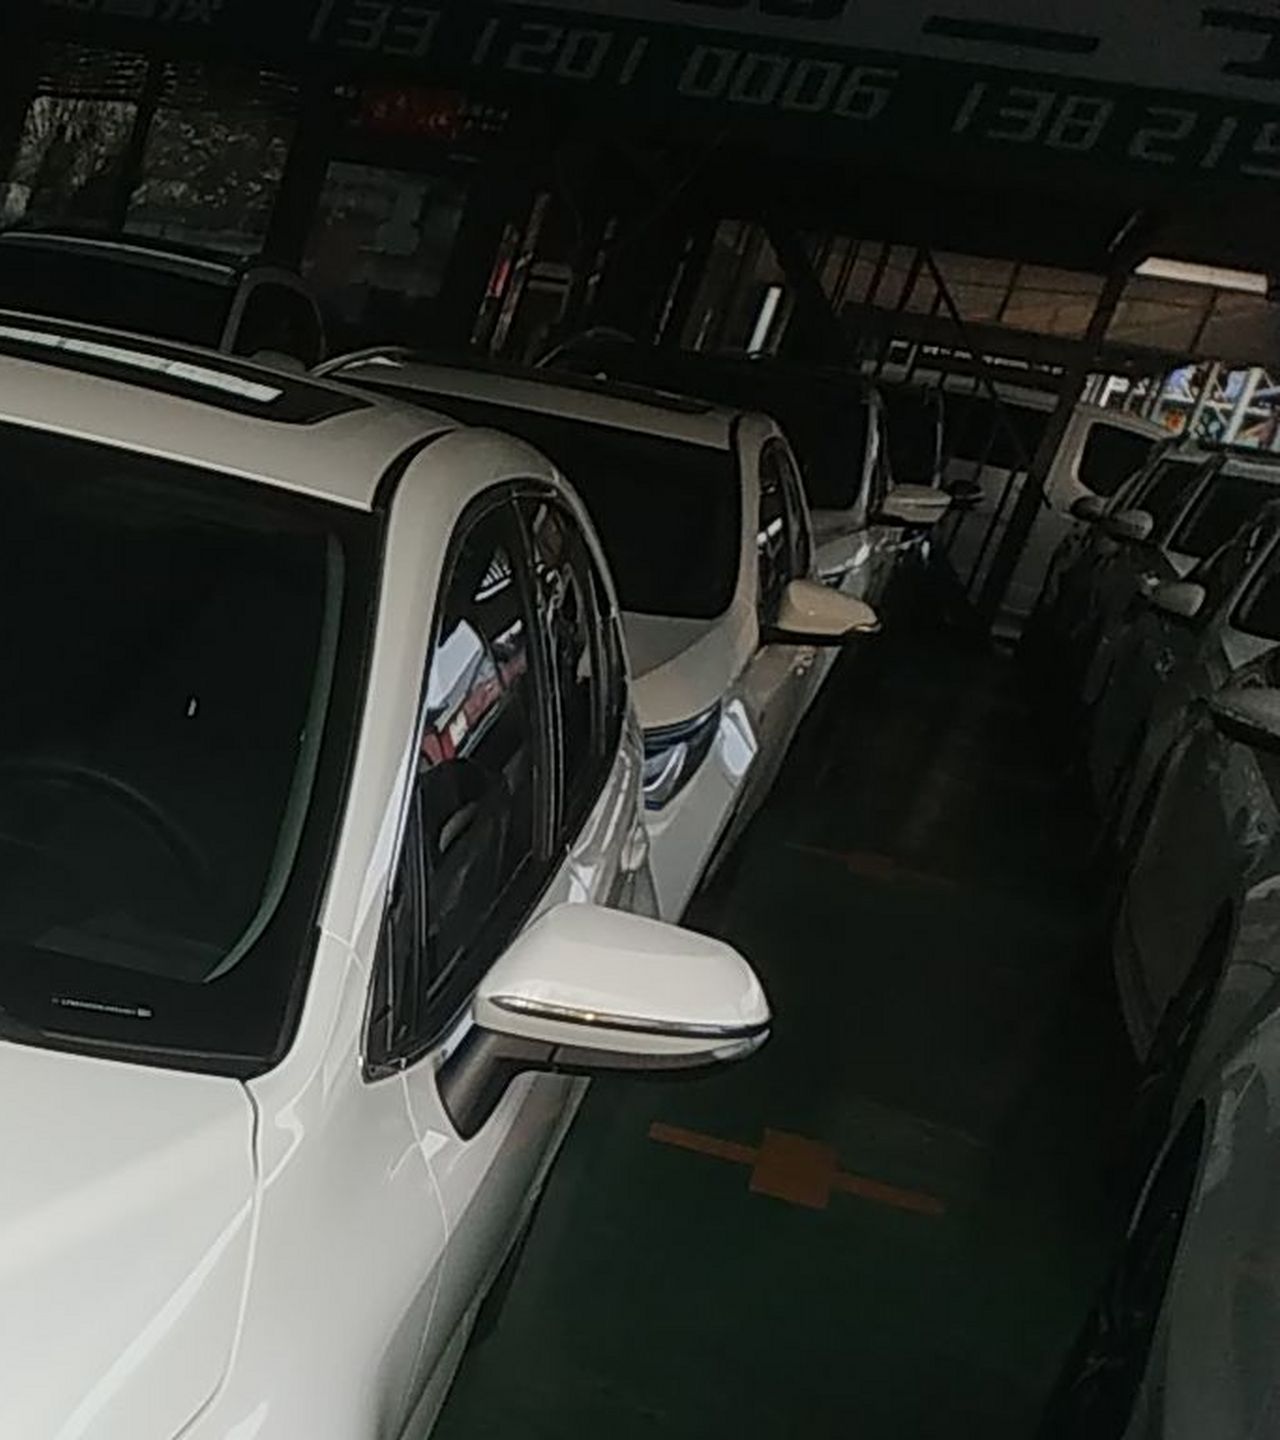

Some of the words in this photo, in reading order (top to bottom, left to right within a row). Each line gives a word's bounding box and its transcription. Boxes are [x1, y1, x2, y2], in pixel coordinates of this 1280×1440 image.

[471, 17, 649, 84] 1201
[677, 44, 900, 120] 0006
[951, 81, 1116, 151] 138
